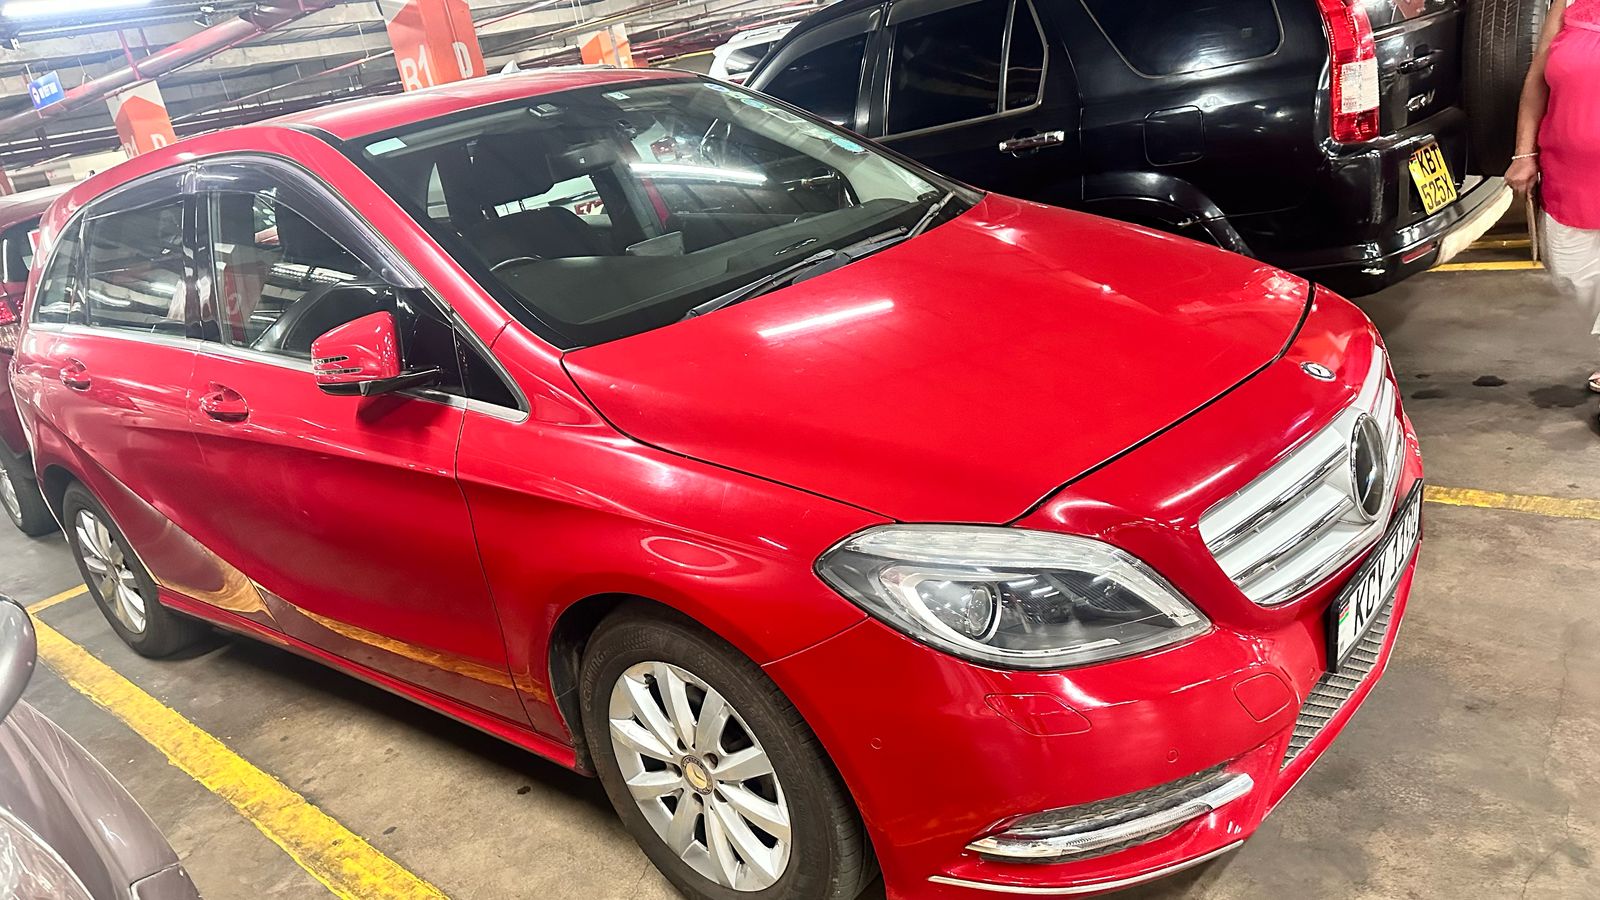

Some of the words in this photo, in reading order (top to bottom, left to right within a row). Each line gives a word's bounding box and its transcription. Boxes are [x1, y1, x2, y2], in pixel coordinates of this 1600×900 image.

[452, 41, 473, 79] D
[1416, 144, 1442, 177] KBT
[1421, 173, 1454, 210] 525X
[1353, 551, 1387, 636] KCY
